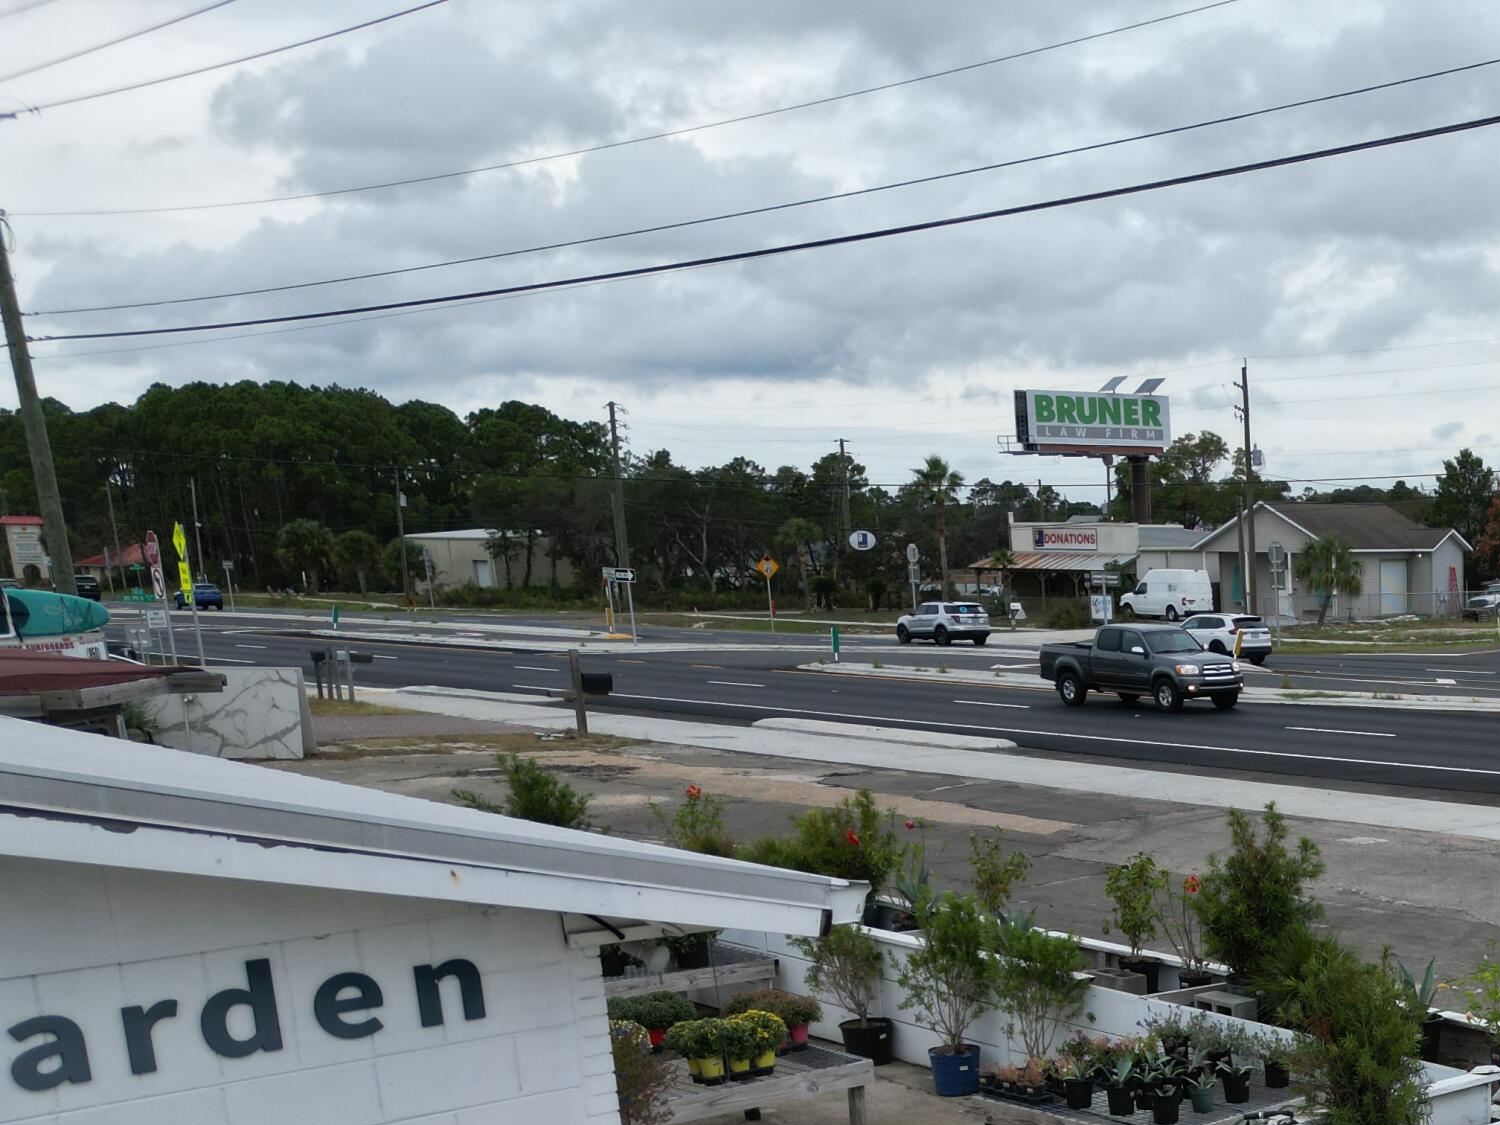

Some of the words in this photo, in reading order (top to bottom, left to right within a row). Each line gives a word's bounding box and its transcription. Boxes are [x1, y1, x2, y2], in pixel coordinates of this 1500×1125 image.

[1034, 394, 1162, 427] BRUNER
[1045, 427, 1087, 438] LAW
[1105, 428, 1156, 440] FIRM
[1044, 533, 1096, 545] DONATIONS
[7, 958, 487, 1091] arden
